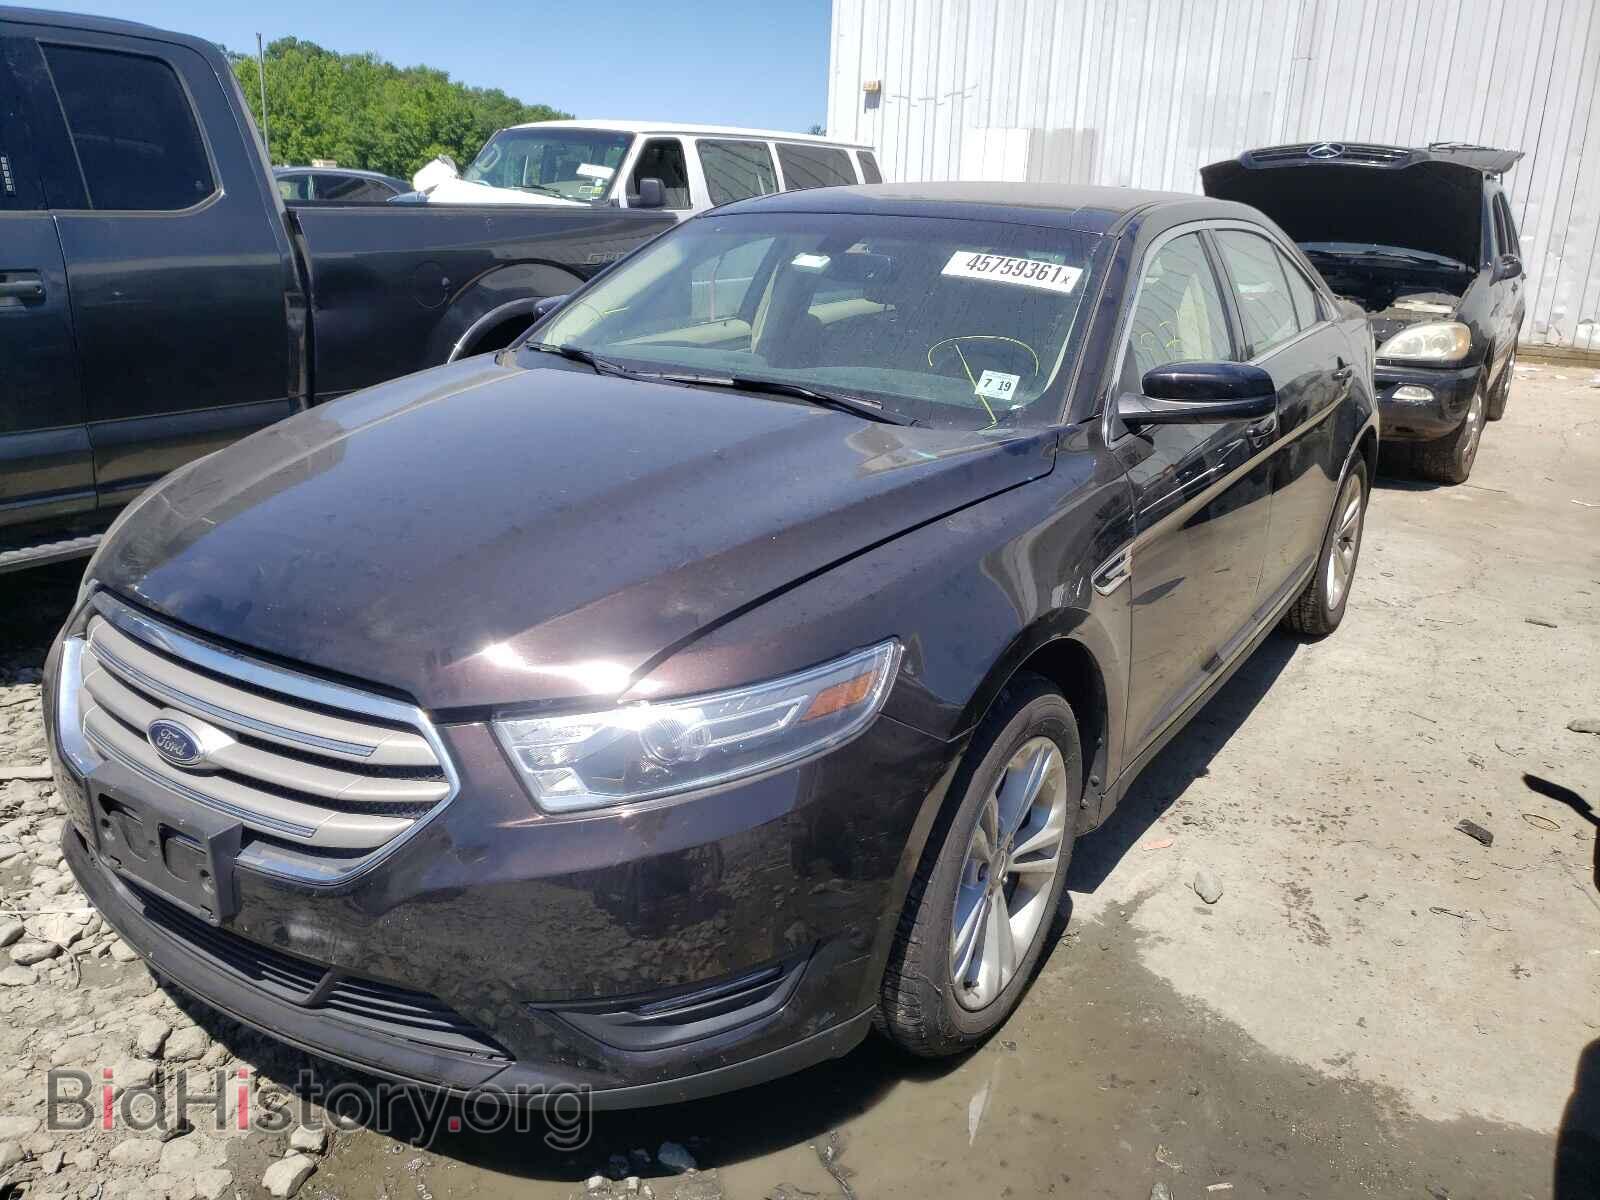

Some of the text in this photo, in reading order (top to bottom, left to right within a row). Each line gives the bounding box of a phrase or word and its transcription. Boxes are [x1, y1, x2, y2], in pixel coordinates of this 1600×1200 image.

[966, 254, 1062, 283] 45759361
[984, 378, 1012, 391] 7 19
[157, 728, 187, 756] Ford
